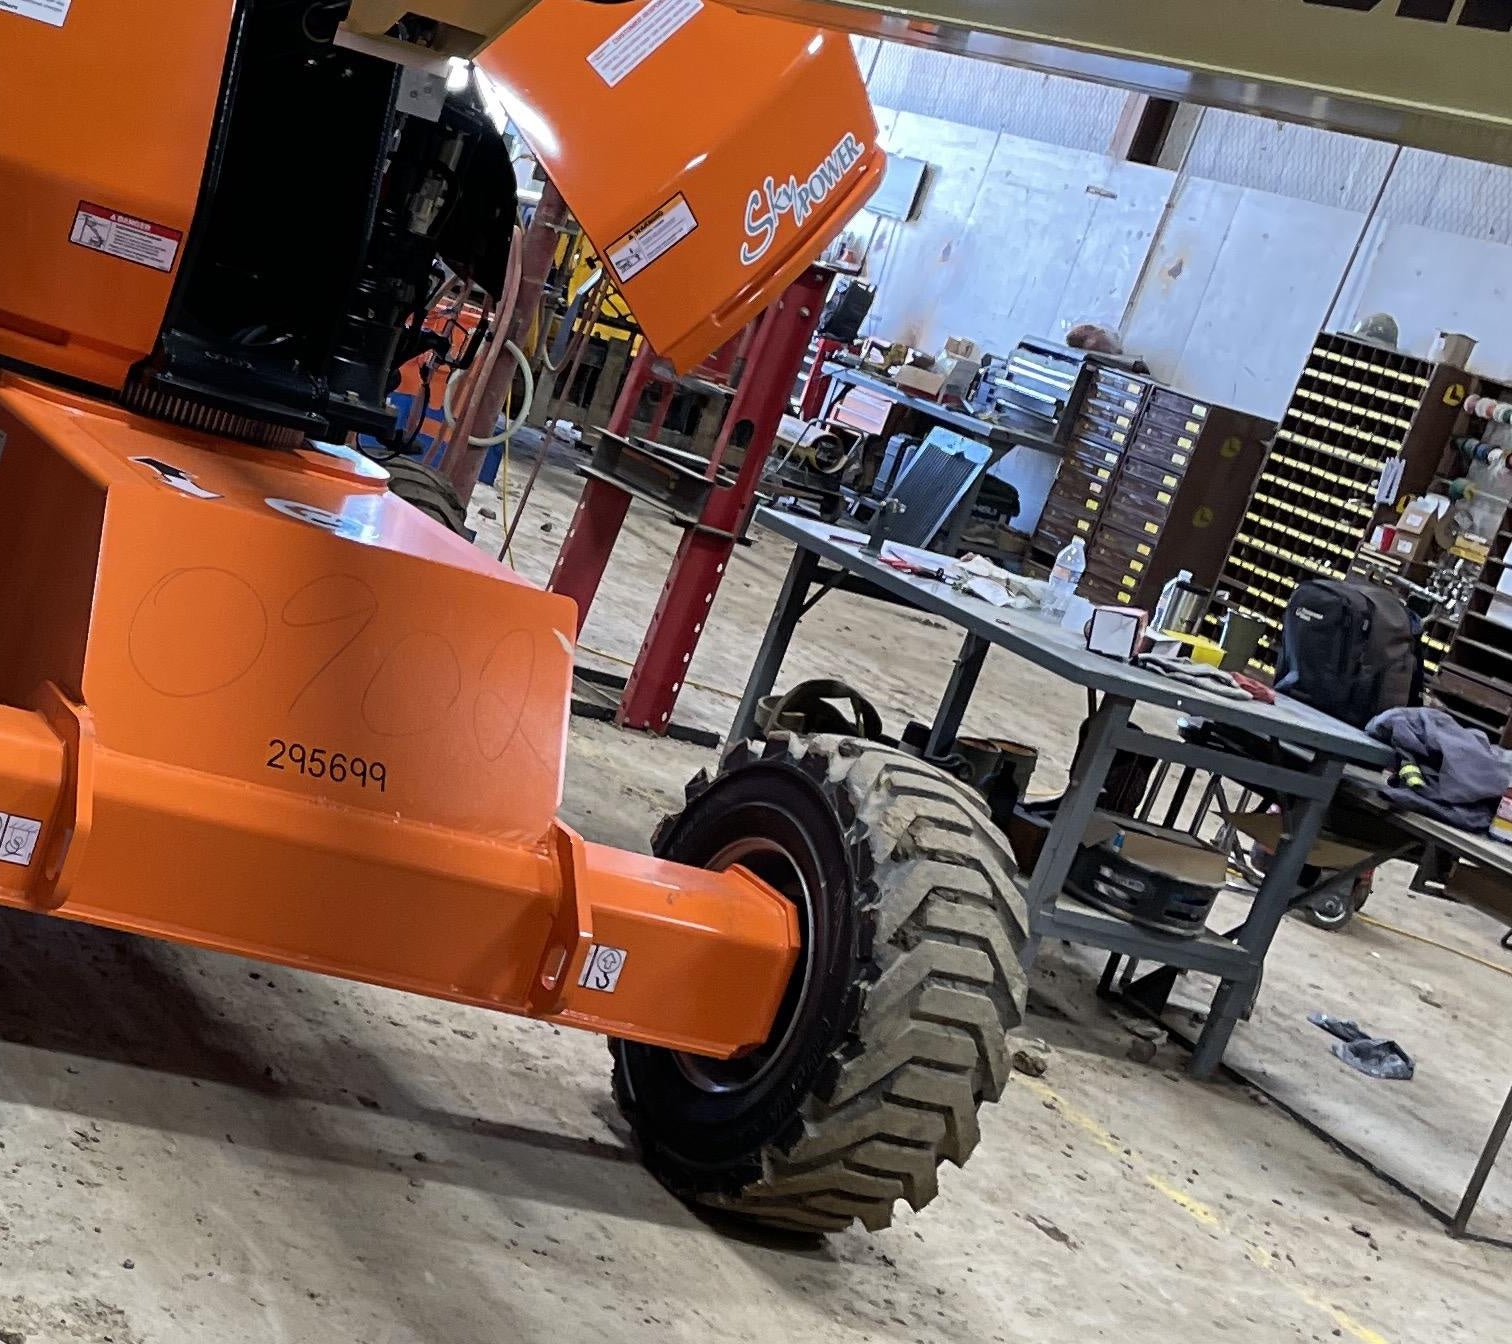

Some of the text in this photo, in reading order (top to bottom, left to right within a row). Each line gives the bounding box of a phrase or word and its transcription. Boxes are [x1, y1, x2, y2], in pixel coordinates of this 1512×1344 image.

[117, 215, 152, 231] DANGER
[634, 210, 664, 235] WARNING
[266, 739, 387, 793] 295699
